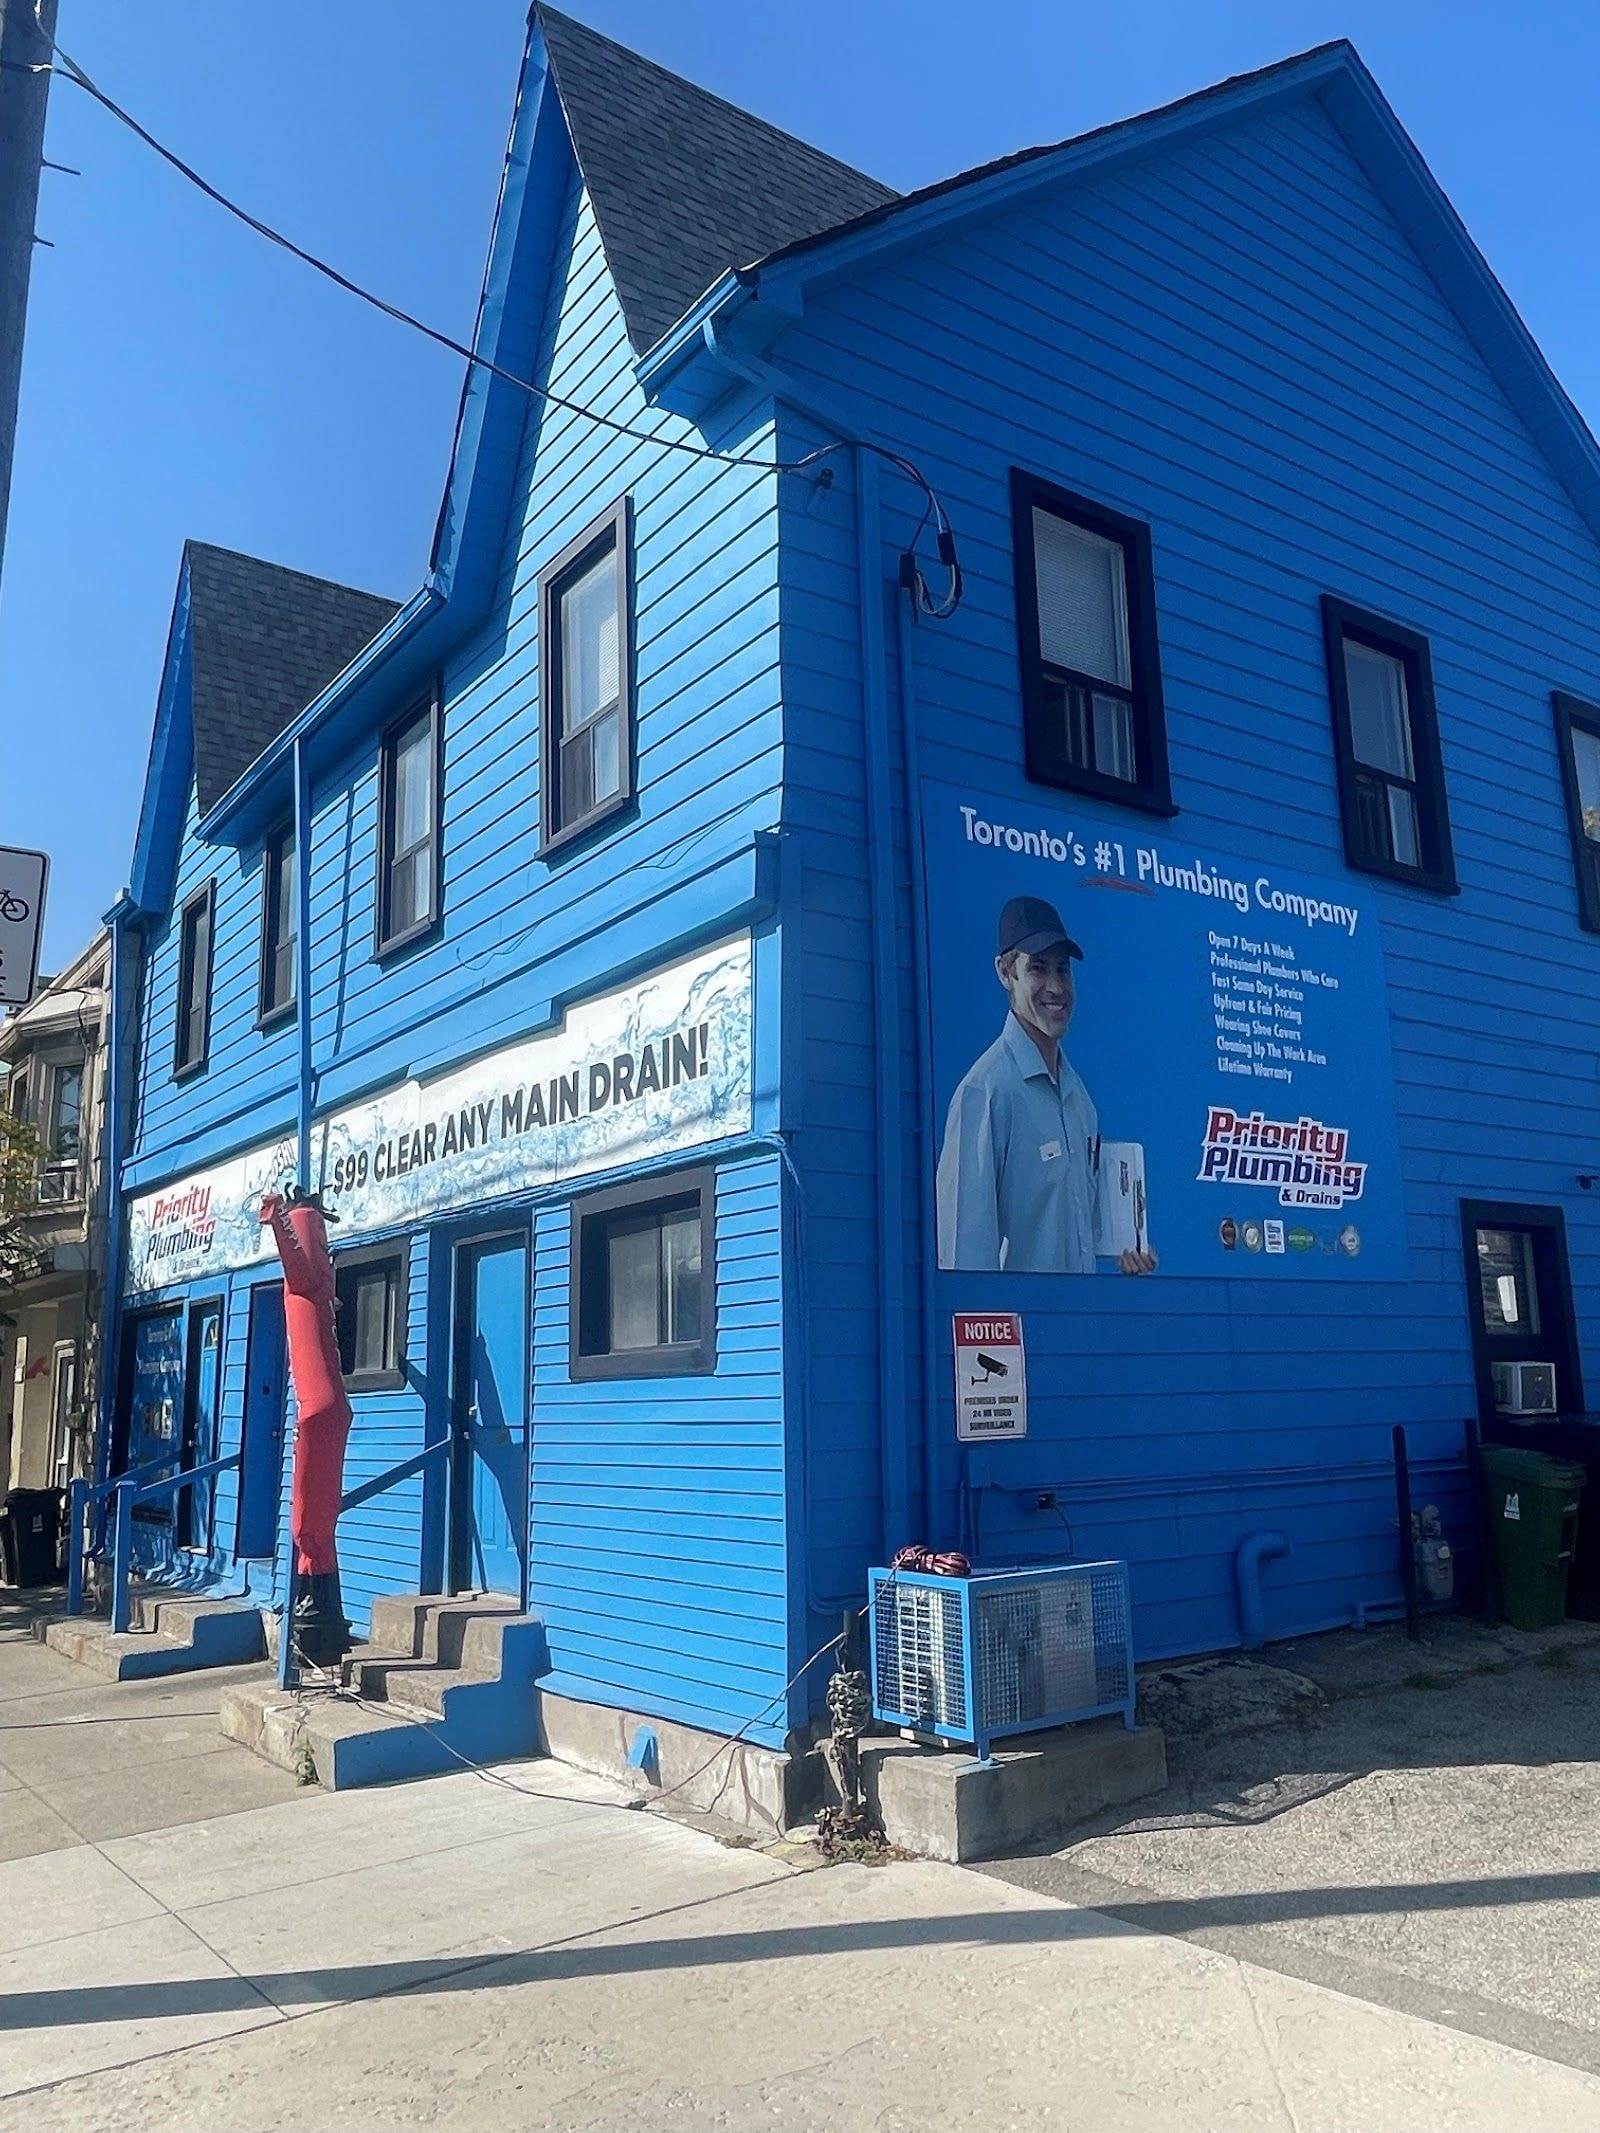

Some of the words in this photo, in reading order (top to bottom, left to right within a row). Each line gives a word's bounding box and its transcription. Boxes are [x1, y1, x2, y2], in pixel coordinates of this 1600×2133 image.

[960, 806, 1086, 866] Toronto's
[1094, 841, 1125, 876] #1
[1136, 849, 1249, 913] Plumbing
[1255, 878, 1358, 936] Company
[1209, 931, 1231, 949] Open
[1233, 936, 1239, 949] 7
[1241, 937, 1261, 956] Days
[1263, 942, 1270, 955] A
[1271, 943, 1295, 960] Week
[1210, 951, 1261, 973] Professional
[1263, 961, 1299, 980] Plumbers
[1301, 969, 1320, 985] Who
[1321, 973, 1339, 989] Care
[1212, 972, 1229, 988] Fast
[1232, 976, 1255, 992] Same
[1256, 980, 1273, 999] Day
[1274, 983, 1304, 1001] Service
[1214, 993, 1246, 1011] Upfront
[1248, 1000, 1255, 1013] &
[1257, 1000, 1272, 1016] Fair
[1274, 1003, 1302, 1025] Pricing
[1215, 1014, 1250, 1037] Wearing
[1252, 1020, 1272, 1036] Shoe
[1274, 1023, 1301, 1040] Covers
[1216, 1036, 1252, 1058] Cleaning
[1253, 1041, 1265, 1059] Up
[1267, 1043, 1281, 1058] The
[1283, 1046, 1305, 1061] Work
[1307, 1050, 1326, 1065] Area
[1218, 1057, 1252, 1075] Lifetime
[1253, 1063, 1292, 1083] Warranty
[333, 1149, 368, 1199] $99
[374, 1122, 437, 1182] CLEAR
[441, 1099, 494, 1158] ANY
[502, 1071, 579, 1140] MAIN
[589, 1023, 708, 1112] DRAIN!
[1208, 1111, 1345, 1162] Priority
[1203, 1146, 1362, 1196] Plumbing
[152, 1184, 211, 1231] Priority
[1282, 1189, 1292, 1202] &
[1296, 1190, 1341, 1205] Drains
[146, 1218, 217, 1264] Plumbing
[964, 1322, 1012, 1340] NOTICE
